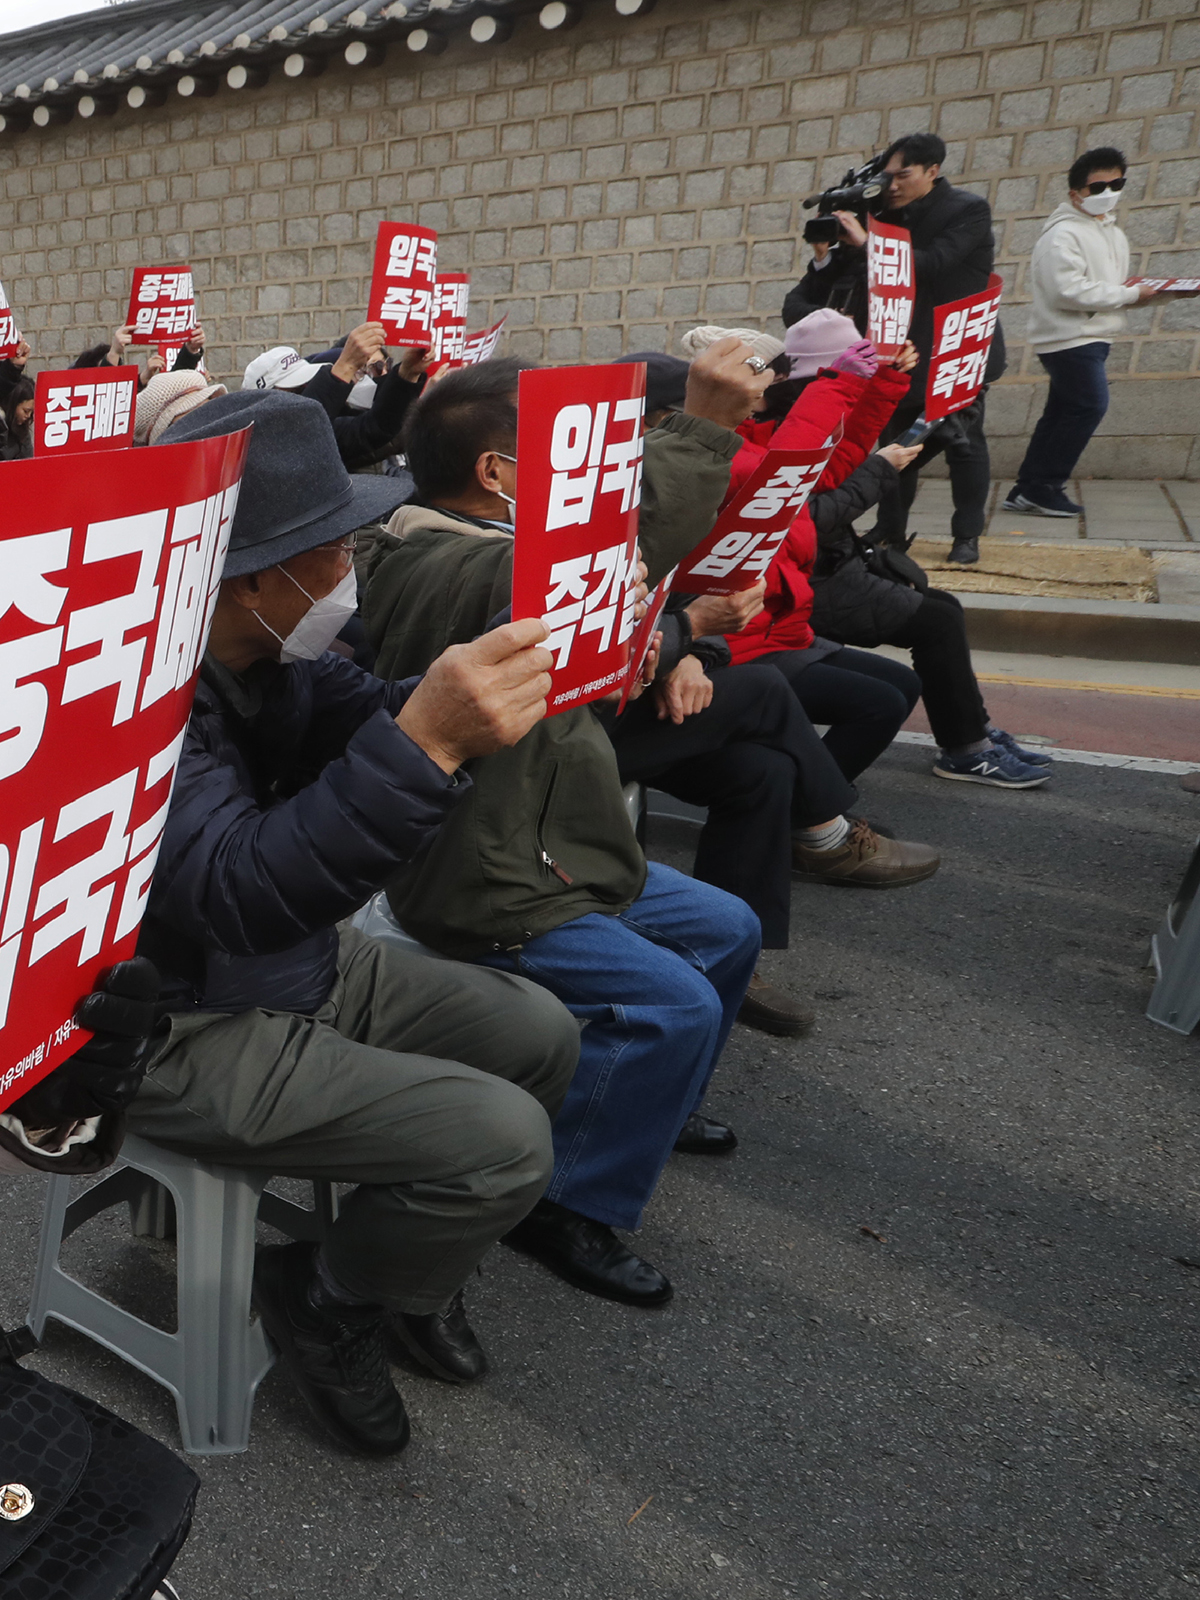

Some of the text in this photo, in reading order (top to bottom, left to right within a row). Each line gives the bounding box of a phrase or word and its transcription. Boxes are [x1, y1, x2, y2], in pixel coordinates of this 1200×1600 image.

[385, 234, 437, 284] 입국
[138, 272, 195, 302] 중국폐
[380, 286, 433, 332] 즉각
[932, 345, 990, 399] 즉각
[44, 380, 133, 448] 중국폐렴
[545, 396, 646, 532] 입국
